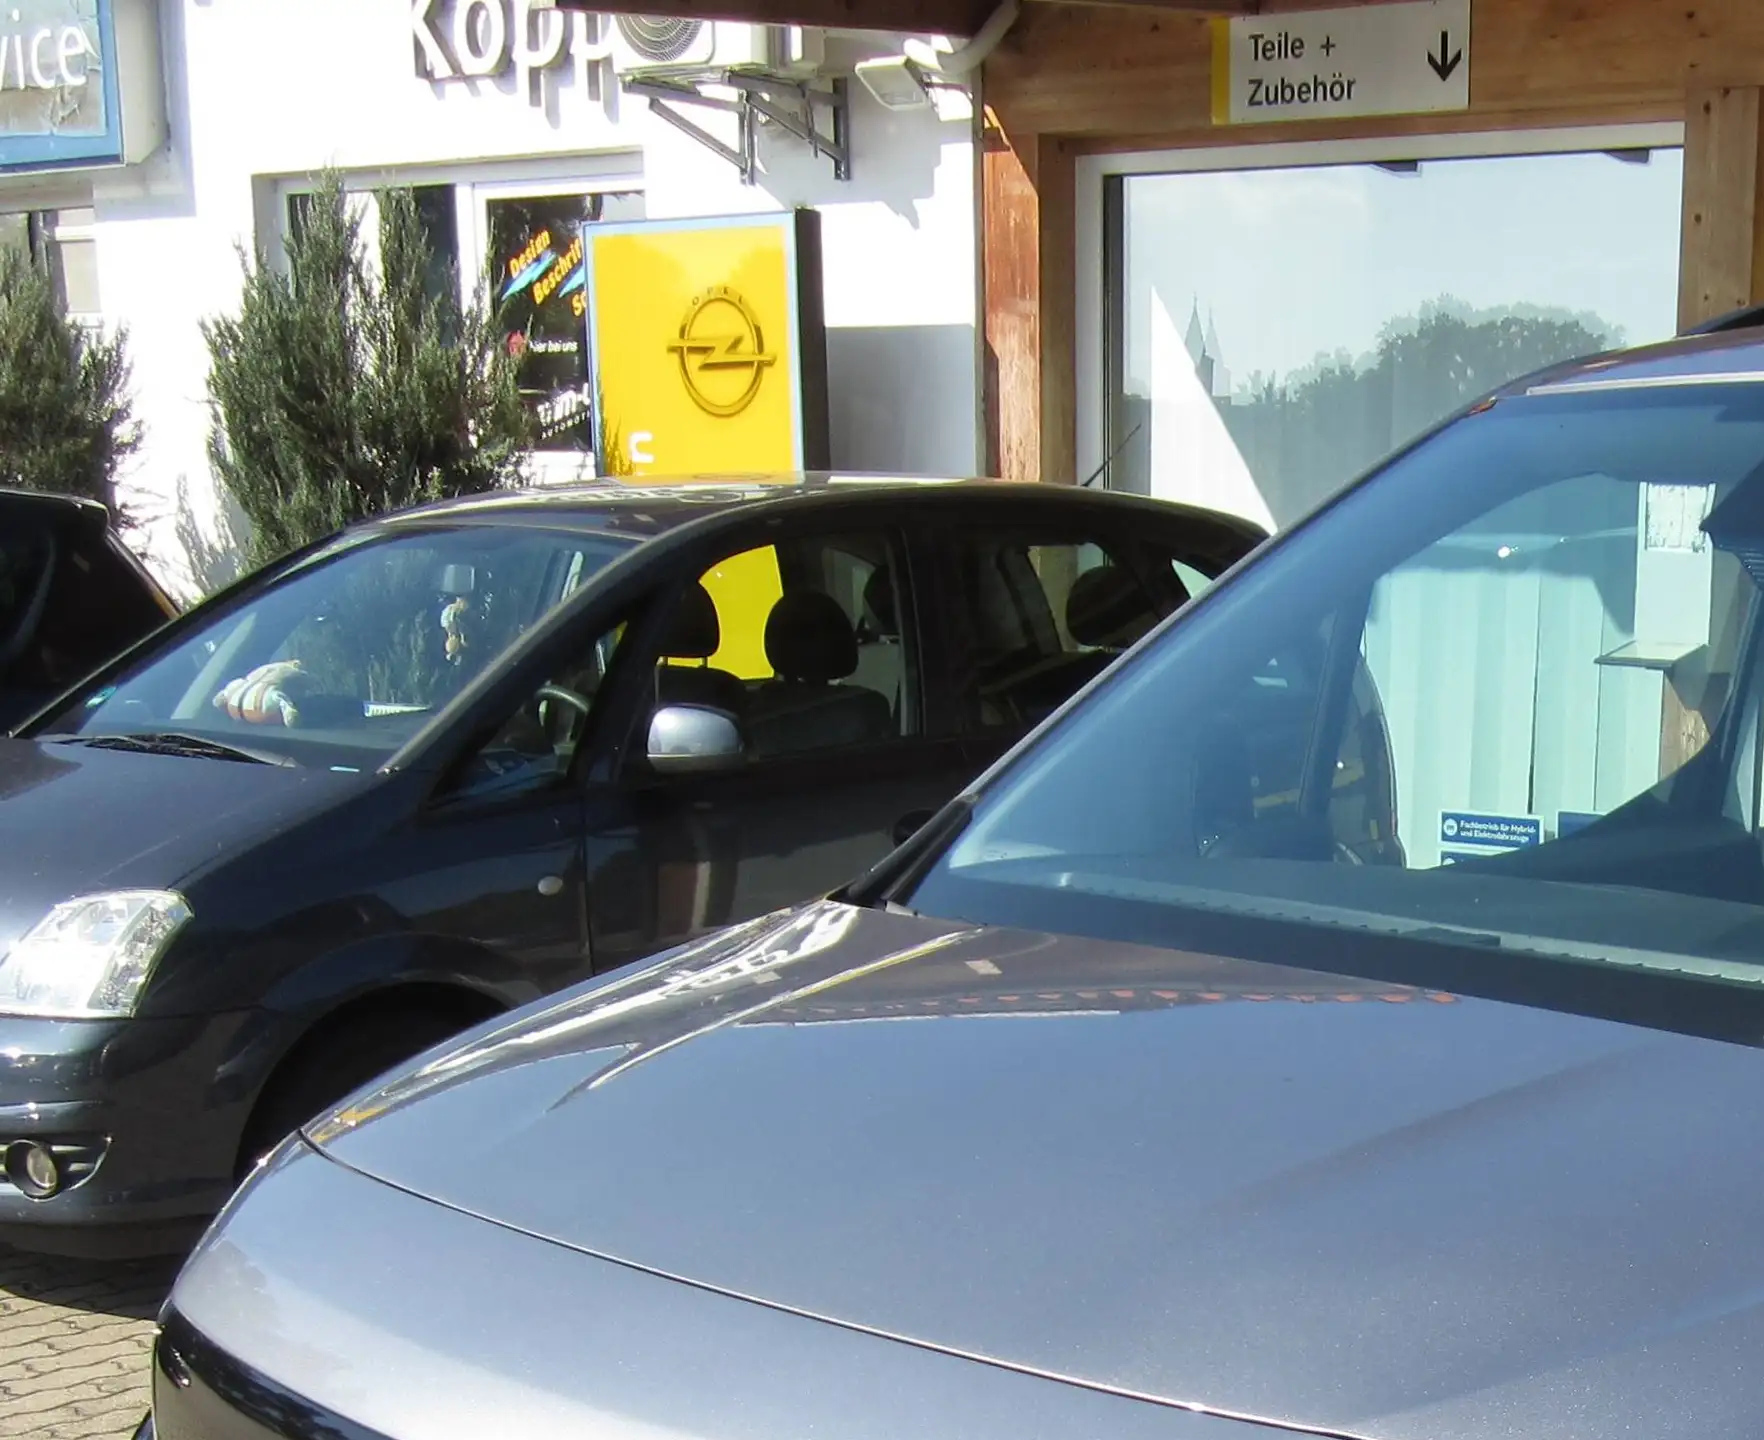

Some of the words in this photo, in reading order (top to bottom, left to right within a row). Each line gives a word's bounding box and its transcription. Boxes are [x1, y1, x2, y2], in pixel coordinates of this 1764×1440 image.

[1248, 31, 1305, 61] Teile
[1247, 72, 1356, 106] Zubehör
[510, 230, 550, 279] Design
